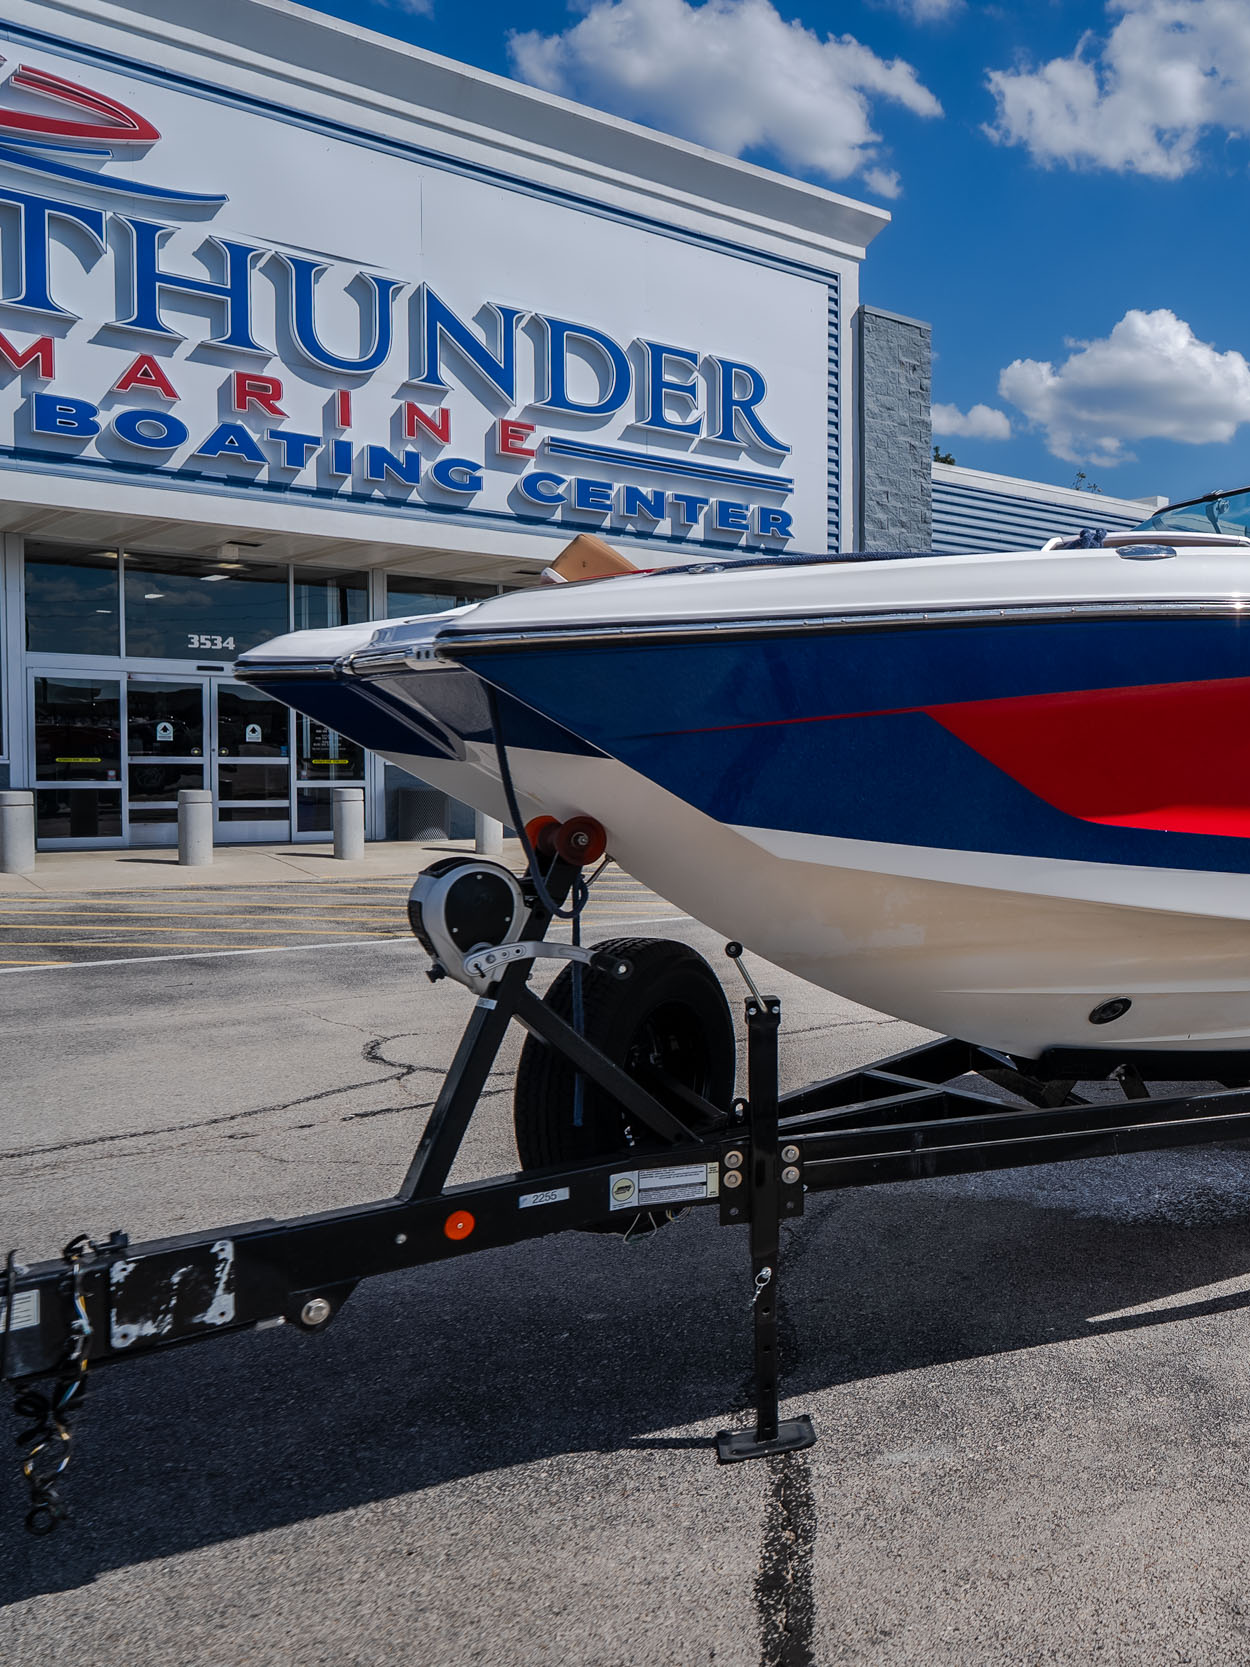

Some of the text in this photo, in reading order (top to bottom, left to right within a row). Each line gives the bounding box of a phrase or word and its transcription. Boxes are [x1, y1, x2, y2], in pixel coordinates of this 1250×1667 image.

[0, 187, 793, 455] THUNDER
[0, 331, 536, 459] MARINE
[31, 391, 796, 540] BOATING CENTER
[187, 634, 236, 650] 3534
[532, 1190, 557, 1204] 2255
